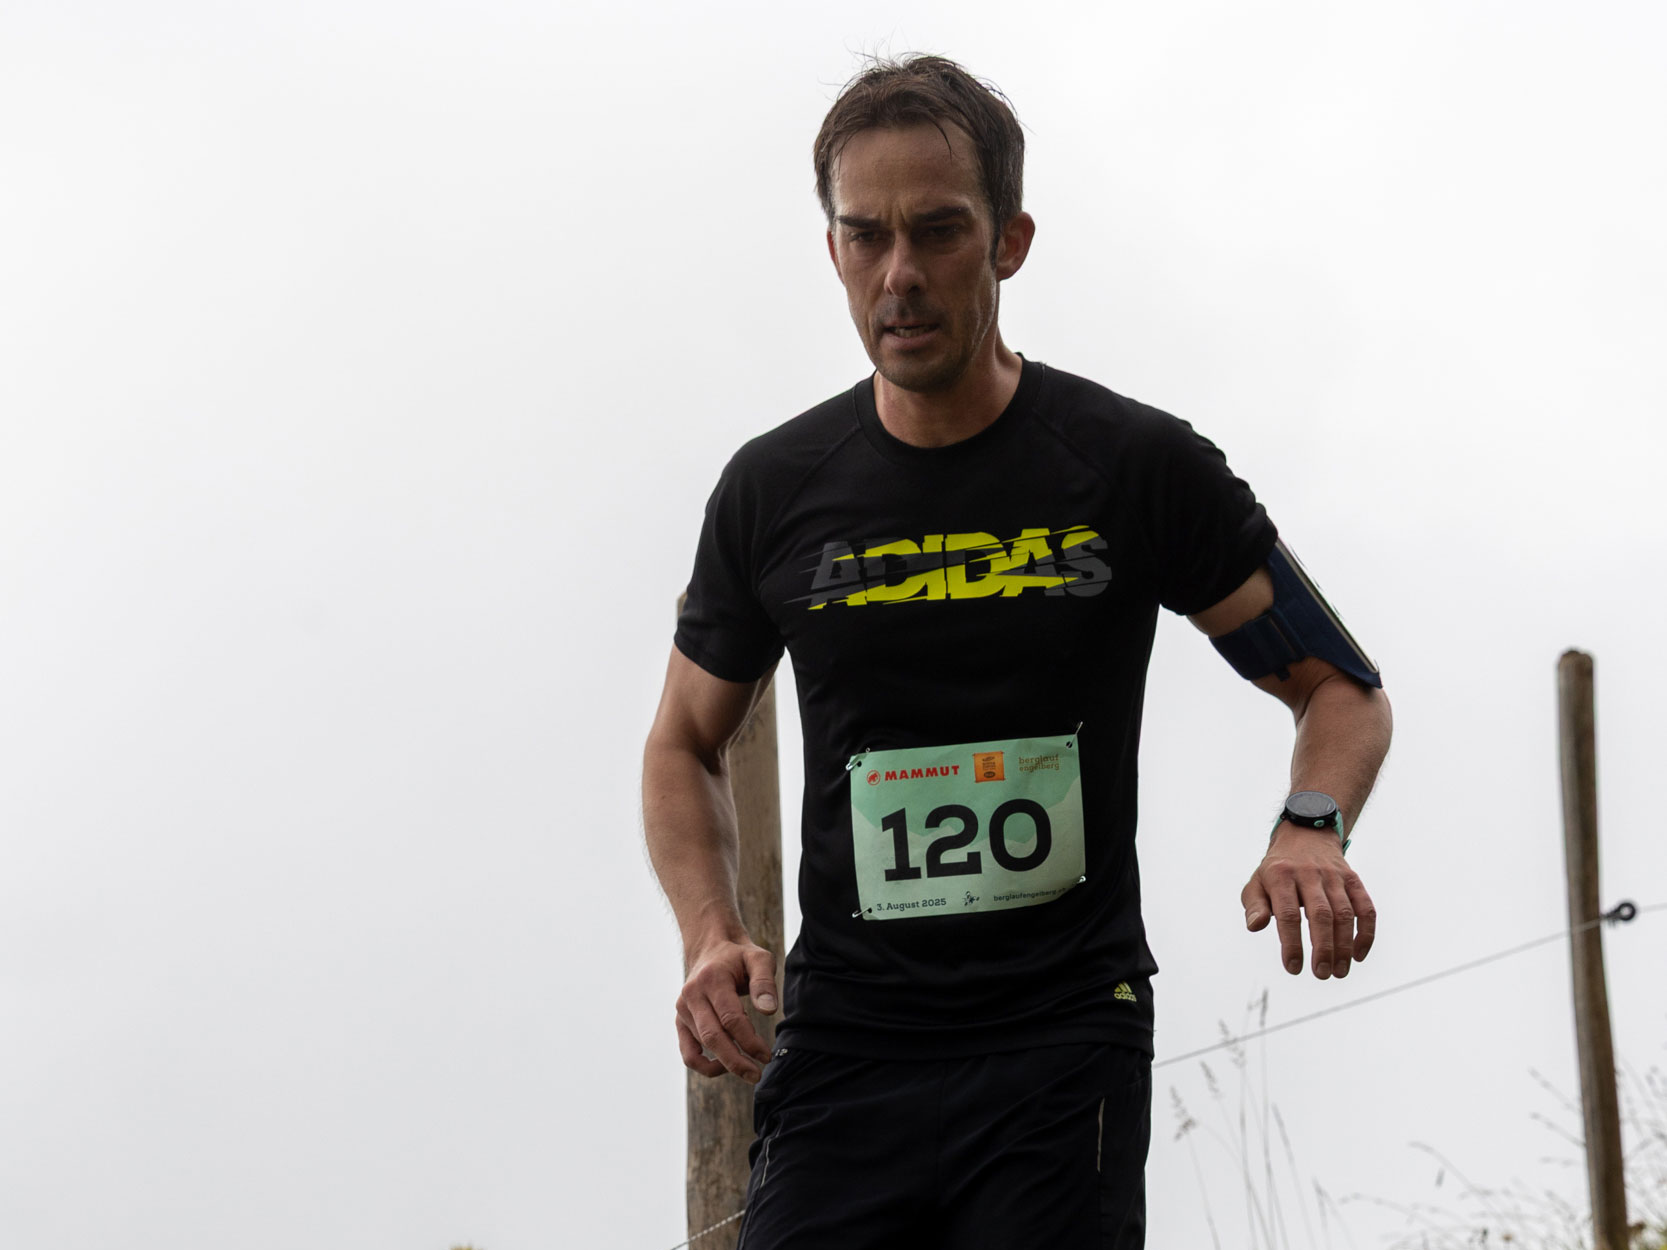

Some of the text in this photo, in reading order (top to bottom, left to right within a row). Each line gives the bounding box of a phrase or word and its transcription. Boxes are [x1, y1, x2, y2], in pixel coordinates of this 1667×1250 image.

[796, 525, 1113, 611] ADIDAS
[885, 765, 960, 781] MAMMUT
[881, 798, 1052, 882] 120
[876, 898, 947, 912] 3. August 2025
